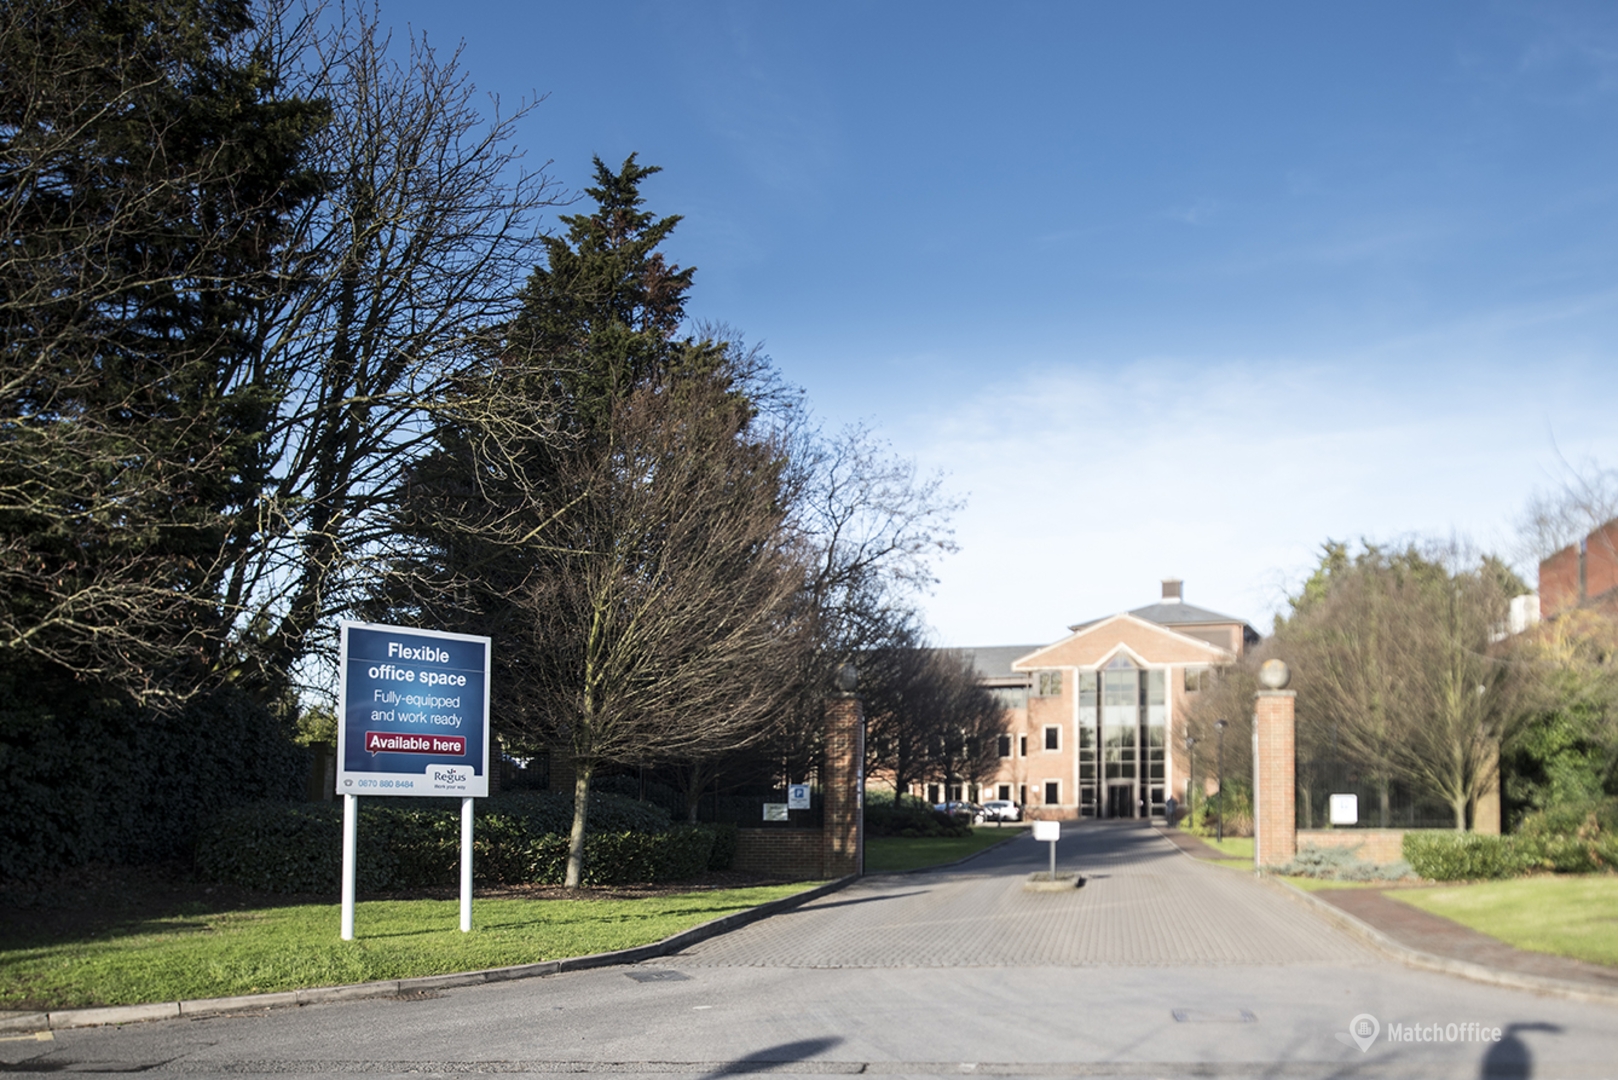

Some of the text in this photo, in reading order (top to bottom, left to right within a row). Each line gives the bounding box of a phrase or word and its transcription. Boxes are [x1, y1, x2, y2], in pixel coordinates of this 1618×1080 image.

[388, 642, 450, 663] Flexible
[368, 665, 467, 687] office space
[374, 689, 461, 709] Fully-equipped
[371, 709, 462, 728] and work ready
[370, 735, 462, 752] Available here
[358, 779, 378, 788] 0870
[379, 779, 394, 788] 880
[434, 769, 467, 784] Regus
